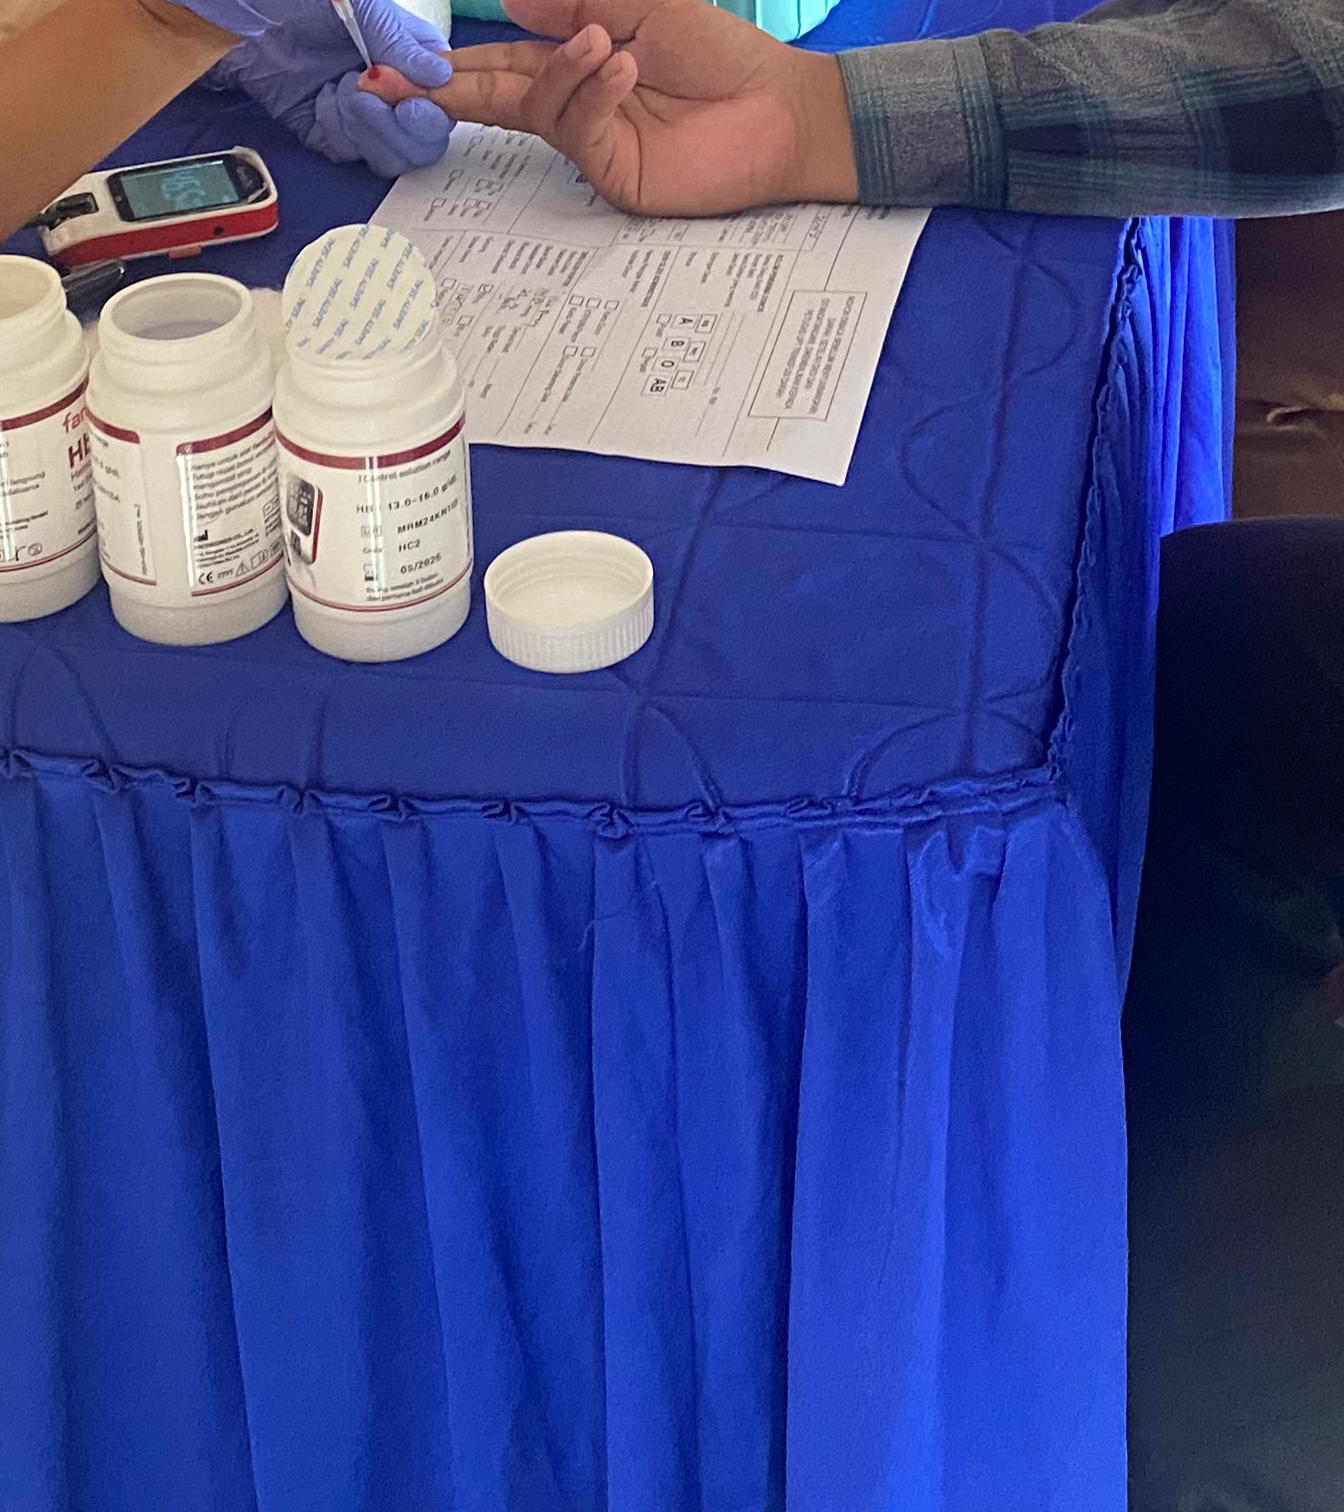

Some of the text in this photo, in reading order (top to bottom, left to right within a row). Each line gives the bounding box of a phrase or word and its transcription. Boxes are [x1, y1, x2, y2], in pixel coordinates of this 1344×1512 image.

[307, 238, 336, 288] SAFETY SEAL
[387, 257, 405, 290] SAFETY
[350, 259, 380, 310] SAFETY SEAL
[312, 278, 343, 328] SAFETY SEAL
[372, 299, 386, 319] SEAL
[393, 279, 424, 330] SAFETY SEAL
[650, 378, 667, 392] AB
[388, 487, 439, 510] 13.0-16.0
[398, 539, 420, 552] HC2
